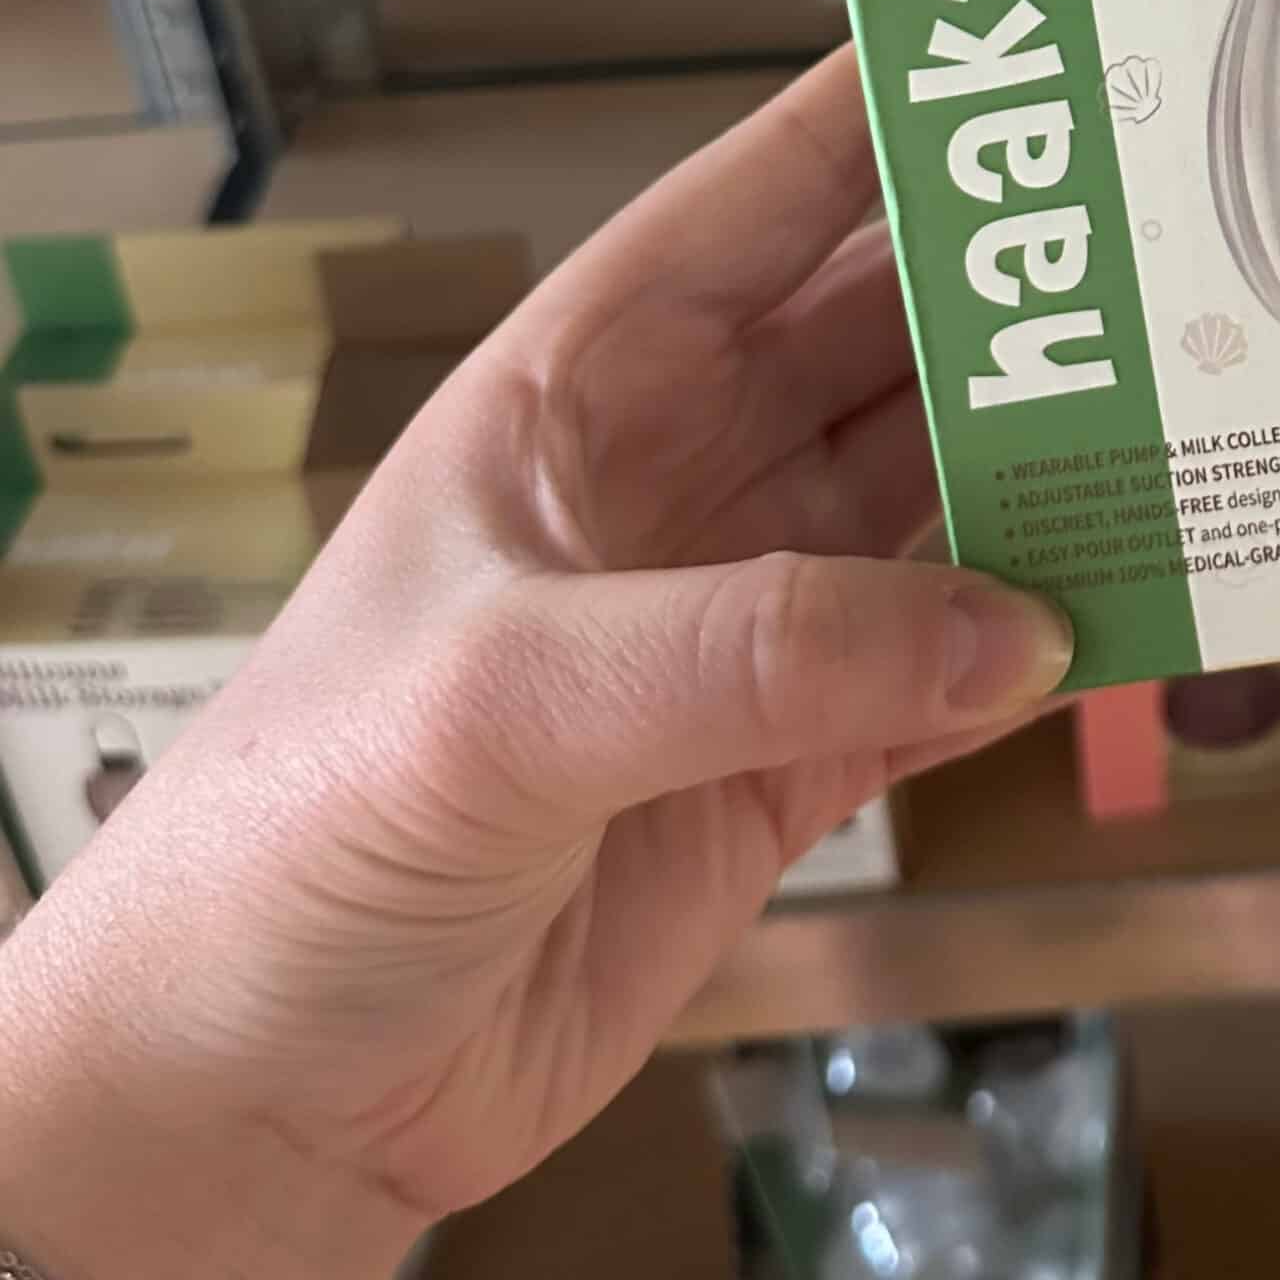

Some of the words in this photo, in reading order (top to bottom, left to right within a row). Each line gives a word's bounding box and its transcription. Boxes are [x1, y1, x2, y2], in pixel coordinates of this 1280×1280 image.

[1011, 449, 1105, 480] WEARABLE
[1110, 445, 1160, 466] PUMP
[1165, 441, 1177, 459] &
[1180, 434, 1225, 458] MILK
[1018, 478, 1126, 509] ADJUSTABLE
[1130, 468, 1207, 493] SUCTION
[1113, 495, 1224, 524] HANDS-FREE
[1029, 548, 1069, 568] EASY
[1075, 540, 1125, 561] POUR
[1129, 526, 1196, 552] OUTLET
[1200, 520, 1232, 542] and
